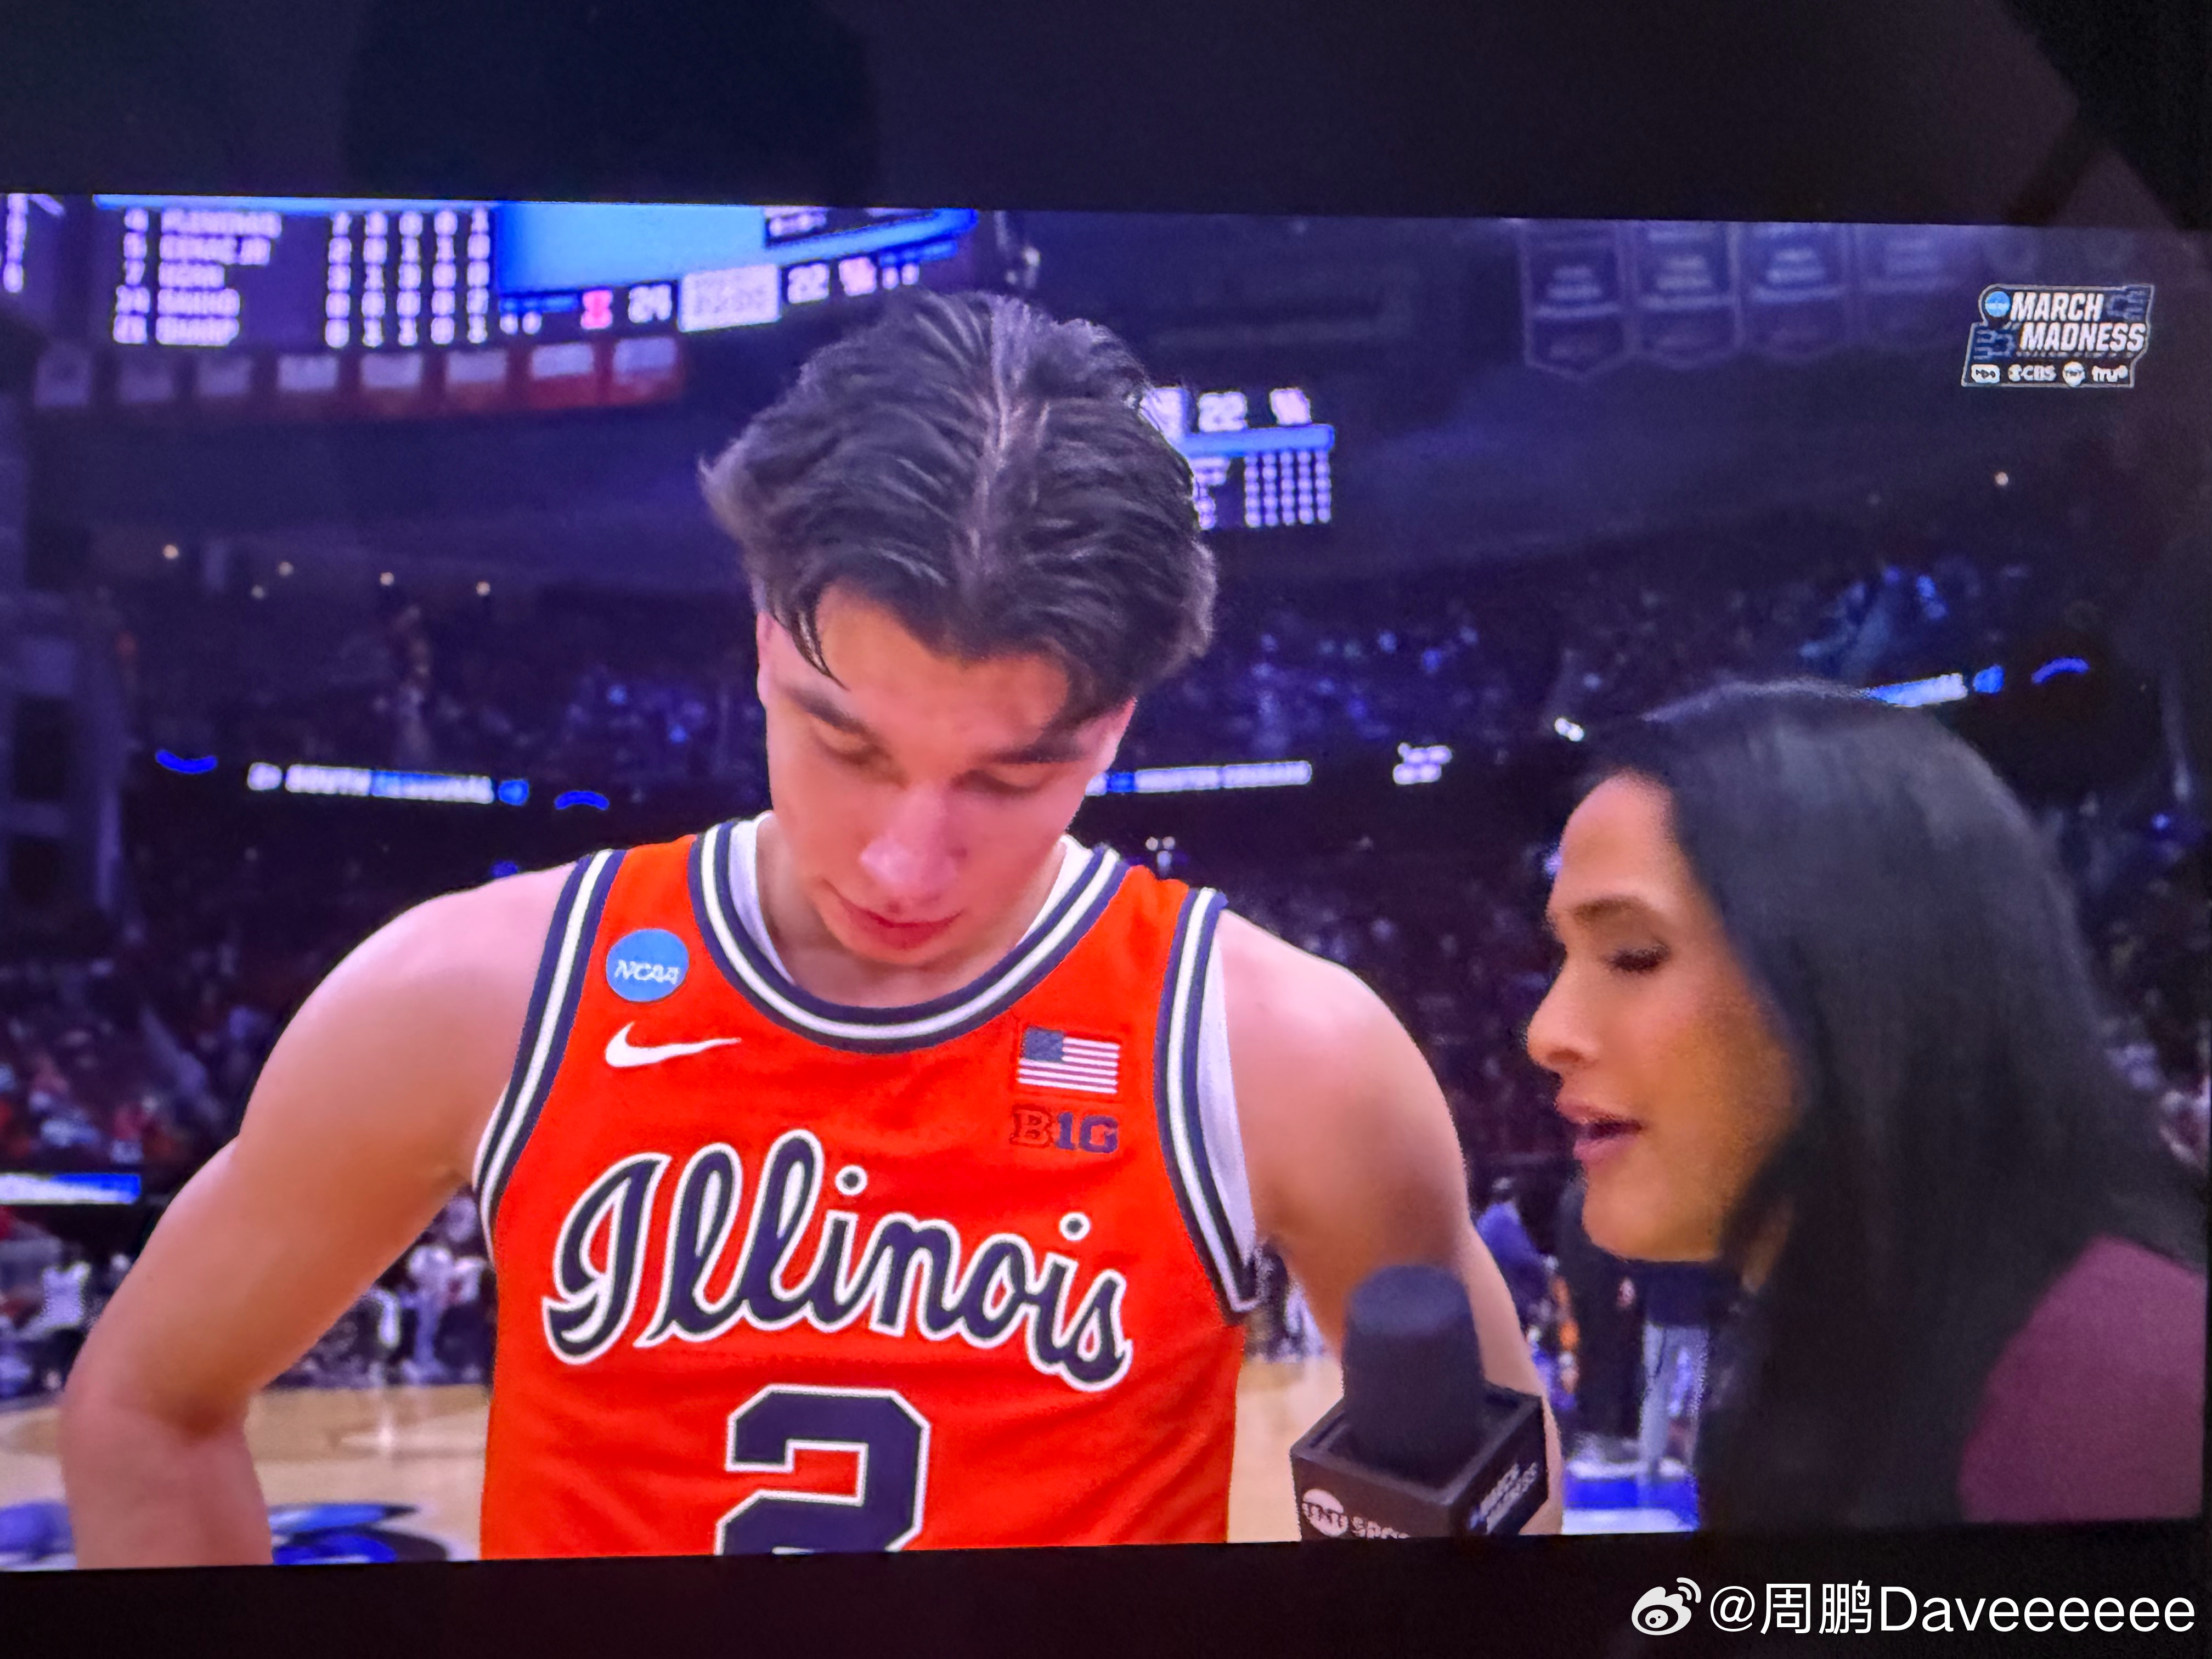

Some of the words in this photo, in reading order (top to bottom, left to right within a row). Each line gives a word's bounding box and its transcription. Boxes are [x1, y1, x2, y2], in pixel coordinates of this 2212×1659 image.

[2010, 292, 2105, 322] MARCH
[2020, 323, 2146, 351] MADNESS
[614, 959, 680, 985] NCAA
[541, 1128, 1132, 1392] Illinois
[715, 1384, 930, 1555] 2
